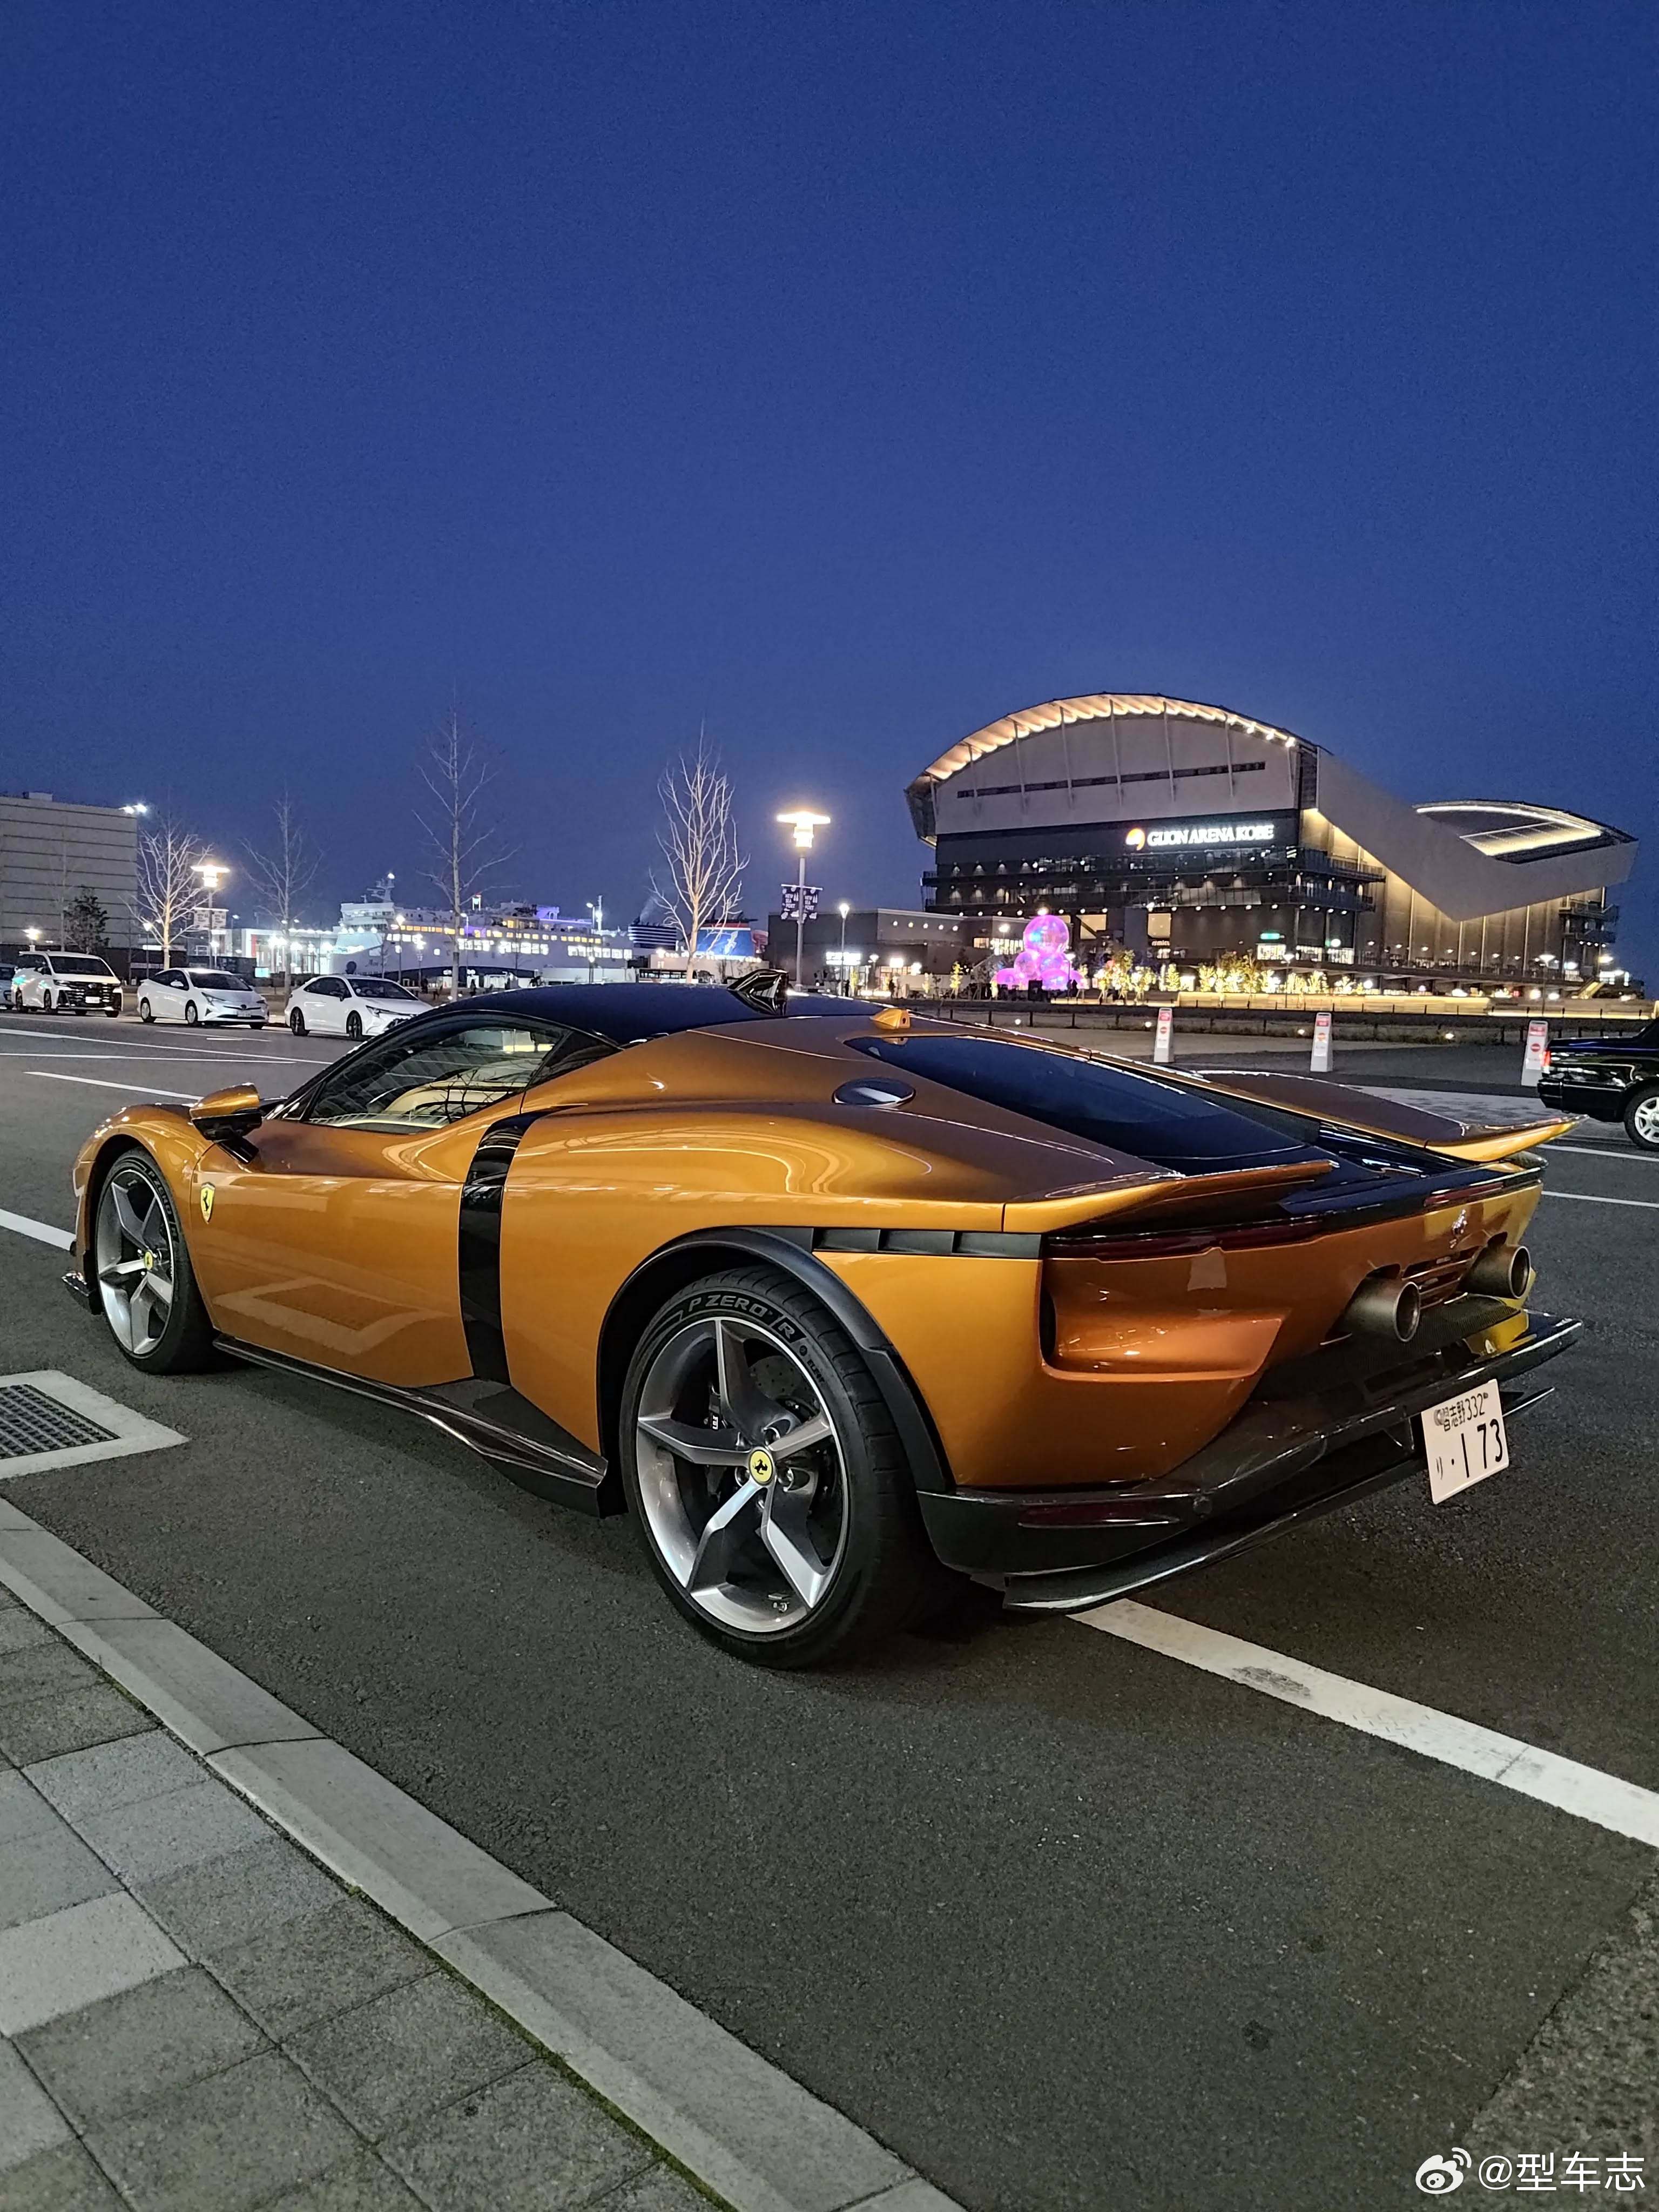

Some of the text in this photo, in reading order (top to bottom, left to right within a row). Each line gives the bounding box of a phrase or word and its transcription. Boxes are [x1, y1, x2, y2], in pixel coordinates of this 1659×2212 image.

[1147, 824, 1274, 846] GLION ARENA KOBE
[689, 1294, 795, 1339] P ZERO R
